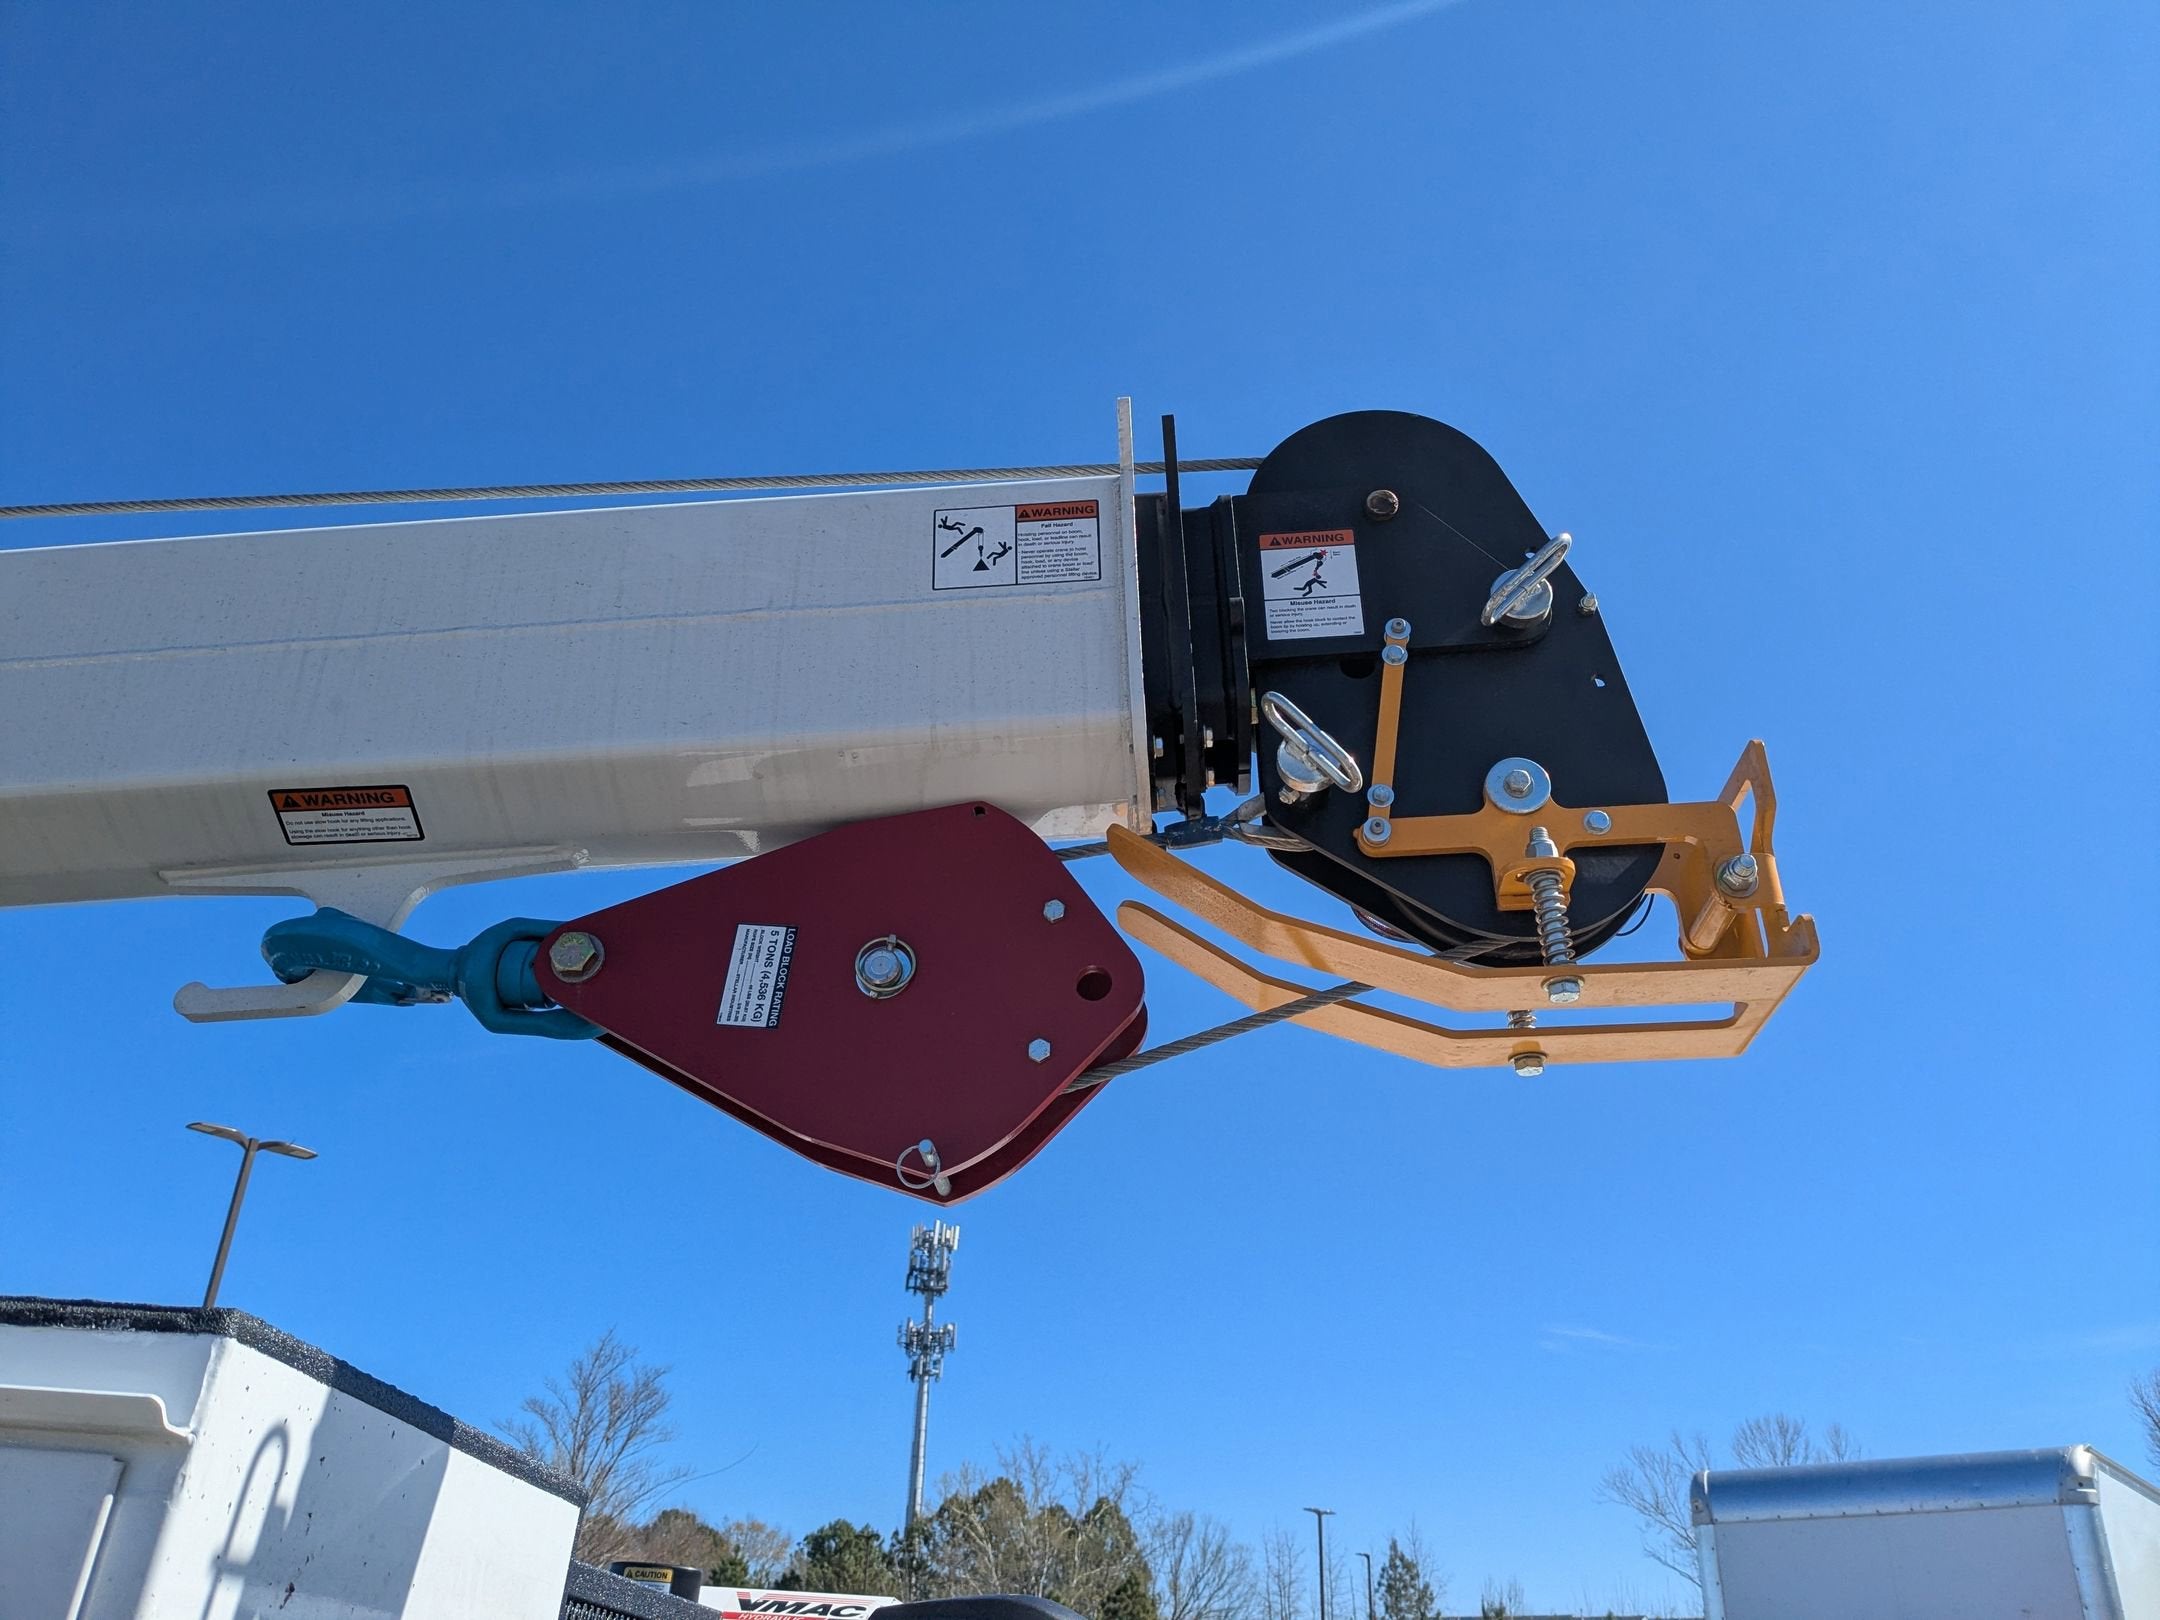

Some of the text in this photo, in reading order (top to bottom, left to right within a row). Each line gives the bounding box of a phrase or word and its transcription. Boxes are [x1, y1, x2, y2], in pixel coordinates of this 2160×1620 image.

[1031, 506, 1094, 516] WARNING
[1281, 534, 1344, 545] WARNING
[301, 791, 395, 807] WARNING
[763, 939, 778, 968] TONS
[757, 970, 772, 1001] (4,536
[768, 928, 796, 1027] LOAD BLOCK RATING
[751, 1004, 765, 1022] KG)
[635, 1570, 668, 1579] CAUTION
[736, 1592, 866, 1617] VMAC
